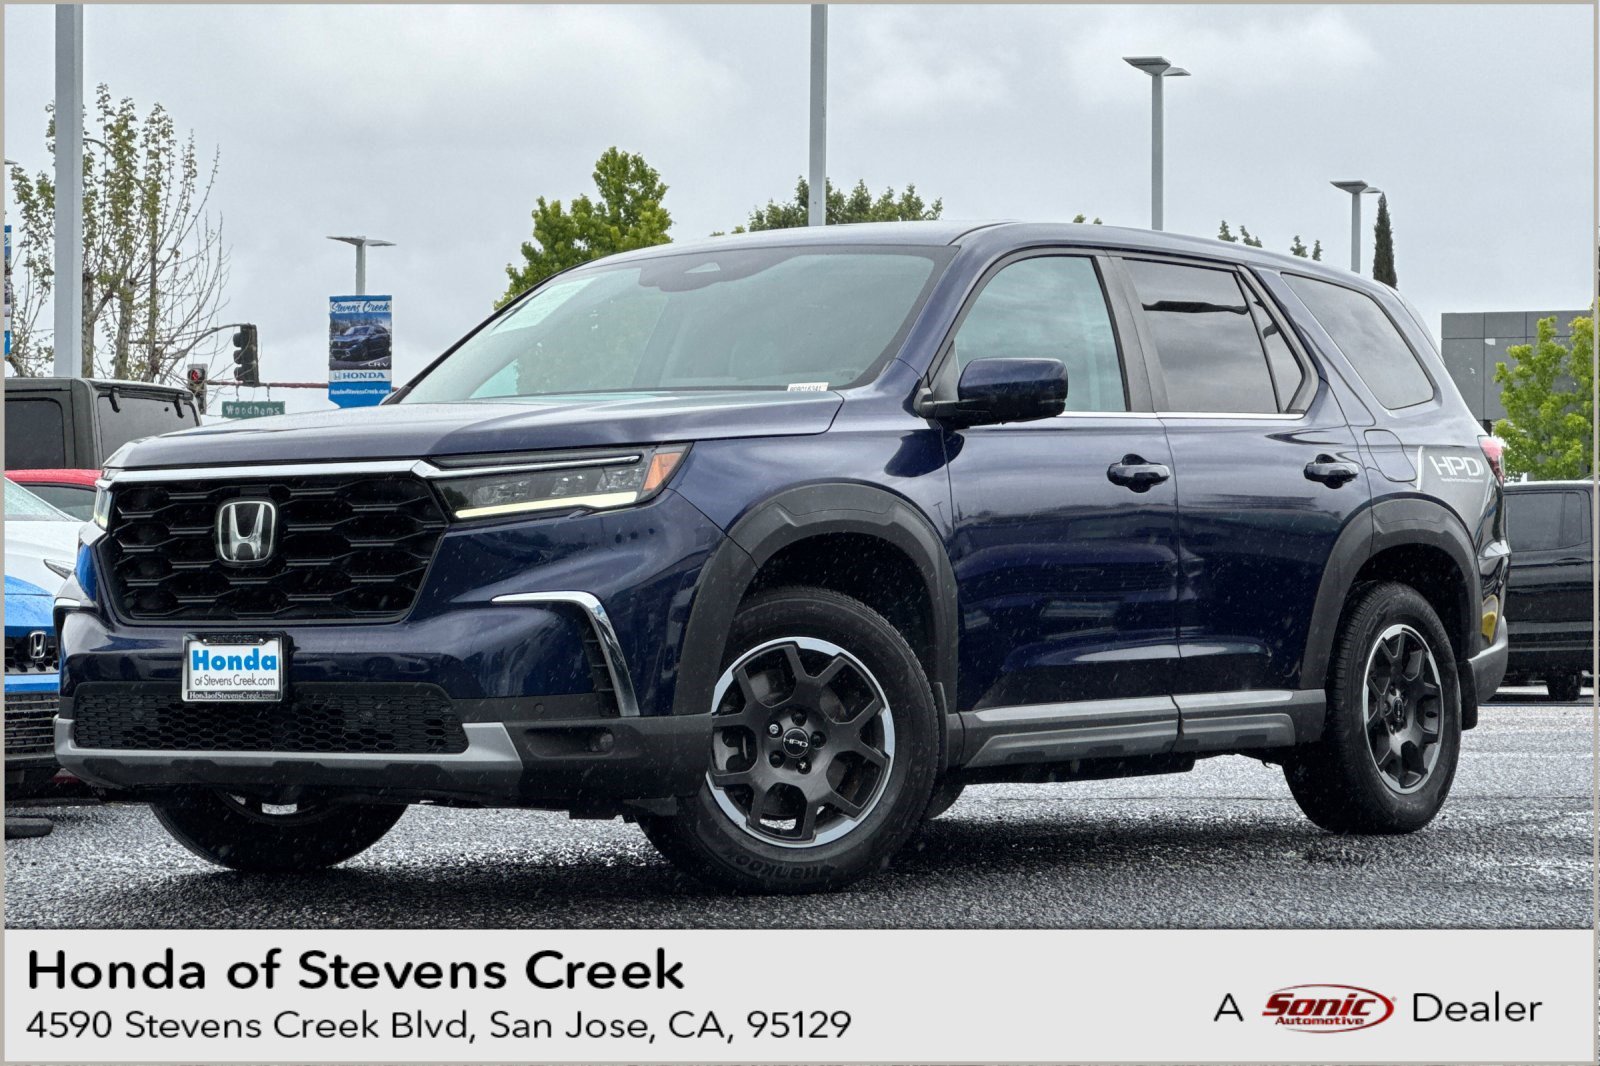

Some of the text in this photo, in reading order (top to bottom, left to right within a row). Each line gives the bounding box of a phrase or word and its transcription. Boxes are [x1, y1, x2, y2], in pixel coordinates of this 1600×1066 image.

[331, 301, 389, 313] Stevens Creek
[226, 404, 280, 415] Woodhams
[1429, 455, 1482, 477] HPD
[192, 648, 277, 671] Honda
[195, 673, 275, 686] of Stevens Creek.com
